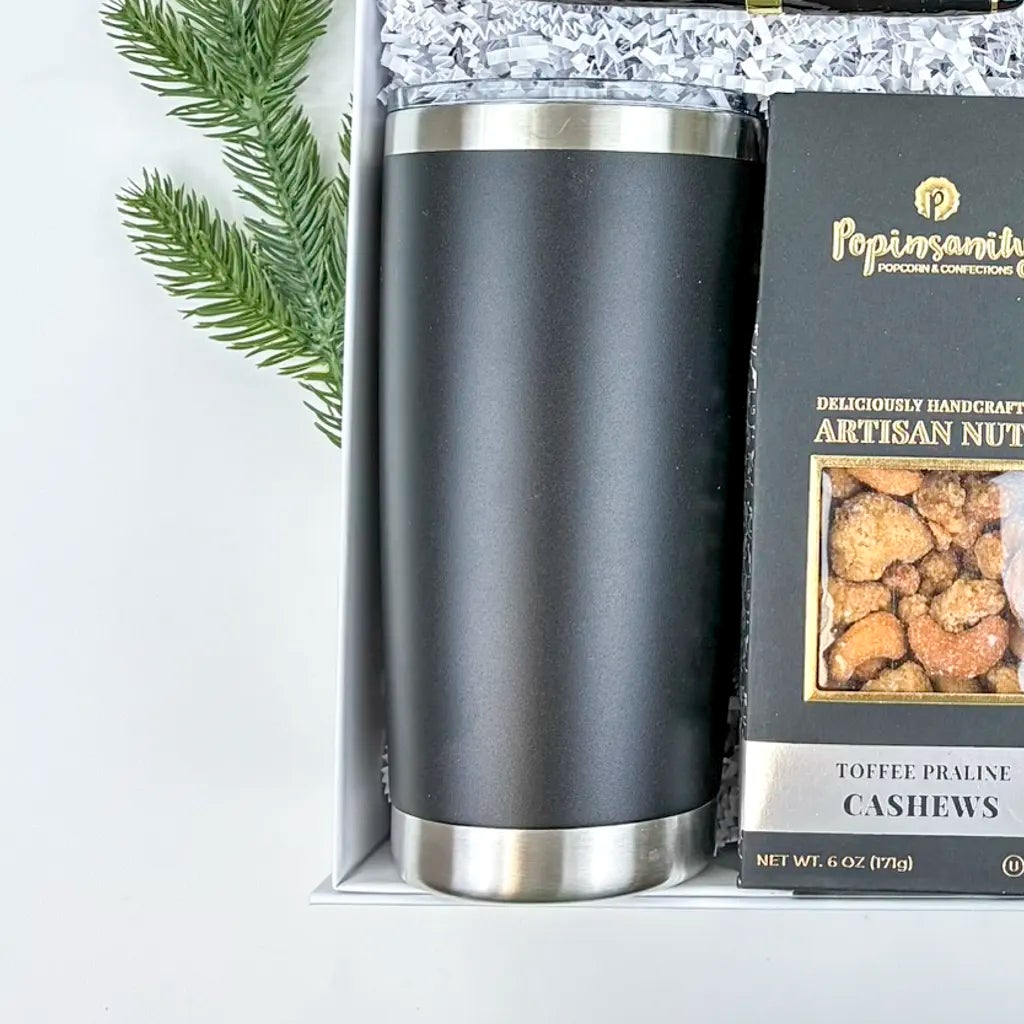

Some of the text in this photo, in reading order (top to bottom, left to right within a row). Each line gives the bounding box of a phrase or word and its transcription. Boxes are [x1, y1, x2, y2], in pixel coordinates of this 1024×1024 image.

[878, 262, 1013, 276] POPCORN & CONFECTIONS
[816, 396, 924, 414] DELICIOUSLY
[813, 418, 952, 446] ARTISAN
[836, 763, 1012, 782] TOFFEE PRALINE
[843, 793, 999, 820] CASHEWS
[756, 854, 914, 873] NET WT. 6 OZ (171g)
